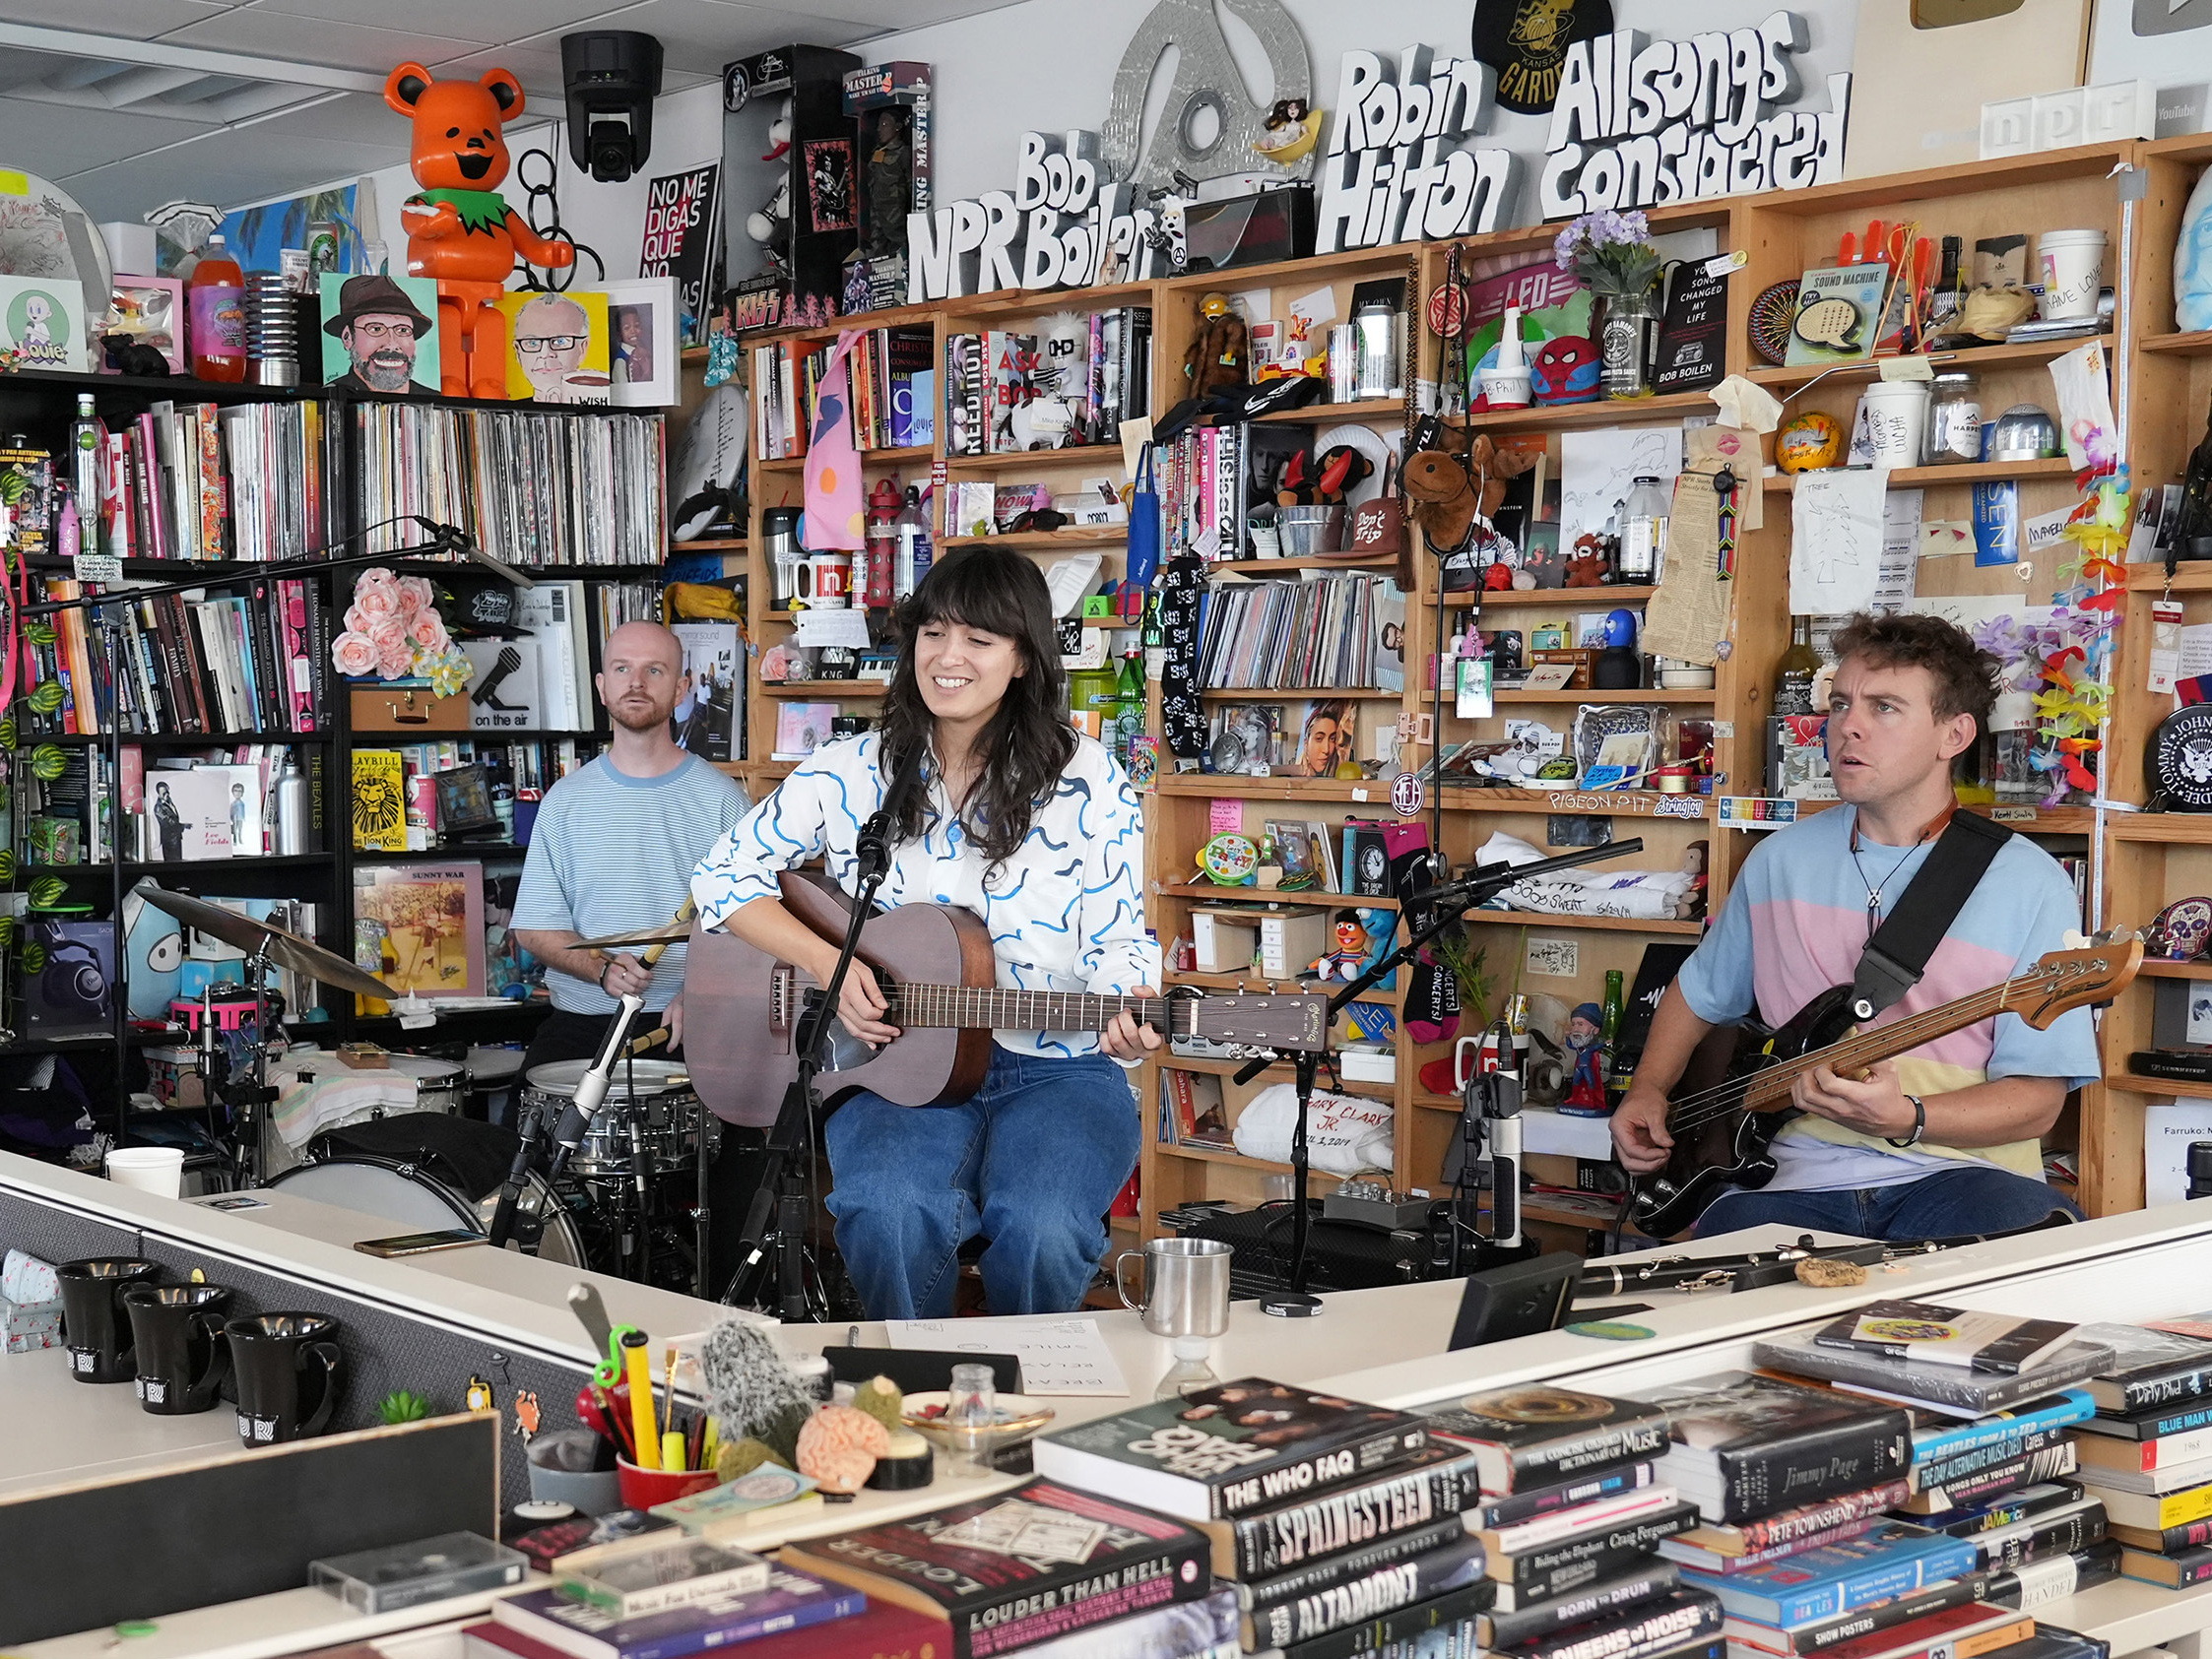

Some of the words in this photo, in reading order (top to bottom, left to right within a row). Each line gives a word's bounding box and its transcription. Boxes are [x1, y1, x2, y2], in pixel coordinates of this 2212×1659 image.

[1522, 51, 1562, 68] KANSAS
[846, 74, 882, 93] MASTER
[917, 77, 927, 89] P
[1545, 11, 1802, 155] Allsongs
[1328, 43, 1484, 158] Robin
[2158, 104, 2196, 120] YouTube
[917, 94, 928, 168] MASTER
[1994, 96, 2135, 147] npr
[1541, 73, 1852, 222] Considered
[1016, 130, 1096, 214] Bob
[650, 179, 678, 208] NO
[683, 170, 709, 200] ME
[1316, 138, 1514, 255] Hilton
[647, 199, 700, 235] DIGAS
[643, 230, 682, 263] QUE
[907, 191, 1022, 303] NPR
[1022, 182, 1154, 289] Boilen
[1506, 272, 1549, 312] LED
[1691, 277, 1716, 288] SONG
[1813, 275, 1841, 288] SOUND
[1842, 271, 1880, 286] MACHINE
[1371, 296, 1392, 305] OWN
[1680, 285, 1723, 303] CHANGED
[1691, 300, 1706, 311] MY
[736, 289, 781, 331] KISS
[1686, 312, 1707, 324] LIFE
[18, 340, 68, 361] Louie
[998, 351, 1042, 371] ASK
[1659, 371, 1678, 384] BOB
[1679, 363, 1713, 377] BOILEN
[578, 396, 609, 407] WISH
[914, 418, 934, 434] LOUIE
[966, 396, 981, 453] REED
[1219, 426, 1233, 474] THIS
[138, 463, 147, 476] HANK
[139, 477, 149, 504] WILLIAMS
[1804, 482, 1830, 491] TREE
[995, 495, 1031, 508] NOW
[1357, 510, 1386, 529] Don't
[1219, 514, 1233, 560] CALL
[1355, 528, 1383, 543] Trip
[823, 571, 840, 591] n
[176, 606, 188, 638] MAX'S
[311, 593, 320, 627] LEONARD
[57, 638, 67, 667] COMPARE
[174, 635, 184, 652] JAZZ
[261, 628, 271, 660] ROLLING
[313, 628, 322, 668] BERNSTEIN
[168, 647, 181, 678] FAMILY
[178, 654, 187, 672] LIVES
[265, 661, 274, 689] STONES
[316, 670, 322, 678] AT
[821, 670, 842, 679] KNG
[476, 716, 490, 726] on
[493, 715, 511, 726] the
[514, 715, 529, 726] air
[311, 754, 321, 772] THE
[1592, 766, 1617, 775] oyster
[2158, 737, 2179, 794] TOMMY
[312, 774, 323, 829] BEATLES
[1549, 793, 1611, 810] PIGEON
[1616, 795, 1651, 812] PIT
[1656, 796, 1703, 817] Stringjoy
[1722, 798, 1774, 819] SOYUZ
[363, 835, 381, 845] LION
[382, 835, 402, 847] KING
[1549, 894, 1587, 912] SWEAT
[1431, 965, 1444, 1014] CONCERTS
[1176, 1070, 1188, 1105] Sahara
[1316, 1115, 1339, 1132] JR.
[1339, 1106, 1390, 1127] CLARK
[2164, 1126, 2202, 1135] Farruko:
[2017, 1382, 2030, 1394] ELVIS
[2030, 1377, 2049, 1391] PRESLEY
[2127, 1380, 2160, 1404] Dirty
[2158, 1417, 2183, 1435] BLUE
[2184, 1411, 2206, 1429] MAN
[1527, 1450, 1545, 1465] THE
[1546, 1443, 1584, 1463] CONCISE
[1585, 1433, 1621, 1453] OXFORD
[1621, 1428, 1661, 1456] MUSIC
[1918, 1448, 1934, 1461] THE
[1934, 1436, 1977, 1458] BEATLES
[1978, 1432, 1999, 1448] FROM
[2007, 1427, 2018, 1437] TO
[2018, 1421, 2038, 1438] ZED
[2183, 1439, 2201, 1452] 1968
[1559, 1450, 1608, 1472] DICTIONARY
[1608, 1445, 1621, 1458] OF
[1919, 1466, 1934, 1485] THE
[1935, 1462, 1951, 1481] DAY
[1950, 1452, 1986, 1477] ALTERNATIVE
[1987, 1445, 2007, 1465] MUSIC
[2007, 1440, 2022, 1459] DIED
[2025, 1432, 2044, 1452] Caress
[1223, 1476, 1261, 1510] THE
[1263, 1464, 1313, 1498] WHO
[1316, 1449, 1355, 1483] FAQ
[1783, 1461, 1826, 1494] Jimmy
[1829, 1456, 1860, 1480] Page
[1945, 1481, 1967, 1495] SONGS
[1967, 1475, 1987, 1488] ONLY
[1987, 1469, 2003, 1482] YOU
[2003, 1462, 2026, 1478] KNOW
[1954, 1488, 1971, 1499] SEAN
[1972, 1482, 1996, 1494] MADIGAN
[1278, 1473, 1432, 1563] SPRINGSTEEN
[1768, 1521, 1793, 1544] PETE
[1792, 1504, 1856, 1538] TOWNSHEND
[1980, 1507, 2025, 1532] JAMerica
[1608, 1530, 1637, 1550] Craig
[1636, 1520, 1679, 1542] Ferguson
[1259, 1575, 1301, 1600] JOHNNY
[1303, 1566, 1337, 1587] CASH
[1346, 1547, 1398, 1571] FOREVER
[1400, 1532, 1439, 1556] WORDS
[1533, 1554, 1559, 1568] Riding
[1559, 1550, 1571, 1563] the
[1572, 1540, 1604, 1560] Elephant
[1733, 1550, 1758, 1566] WILLIE
[969, 1589, 1057, 1630] LOUDER
[1060, 1572, 1120, 1603] THAN
[1123, 1556, 1174, 1585] HELL
[1296, 1562, 1419, 1639] ALTAMONT
[1557, 1598, 1597, 1621] BORN
[1597, 1594, 1609, 1605] TO
[1610, 1580, 1651, 1604] DRUM
[2024, 1578, 2074, 1608] HANDEL
[1550, 1630, 1630, 1659] QUEENS
[1643, 1605, 1702, 1640] NOISE
[1815, 1628, 1839, 1645] SHOW
[1839, 1618, 1874, 1639] POSTERS
